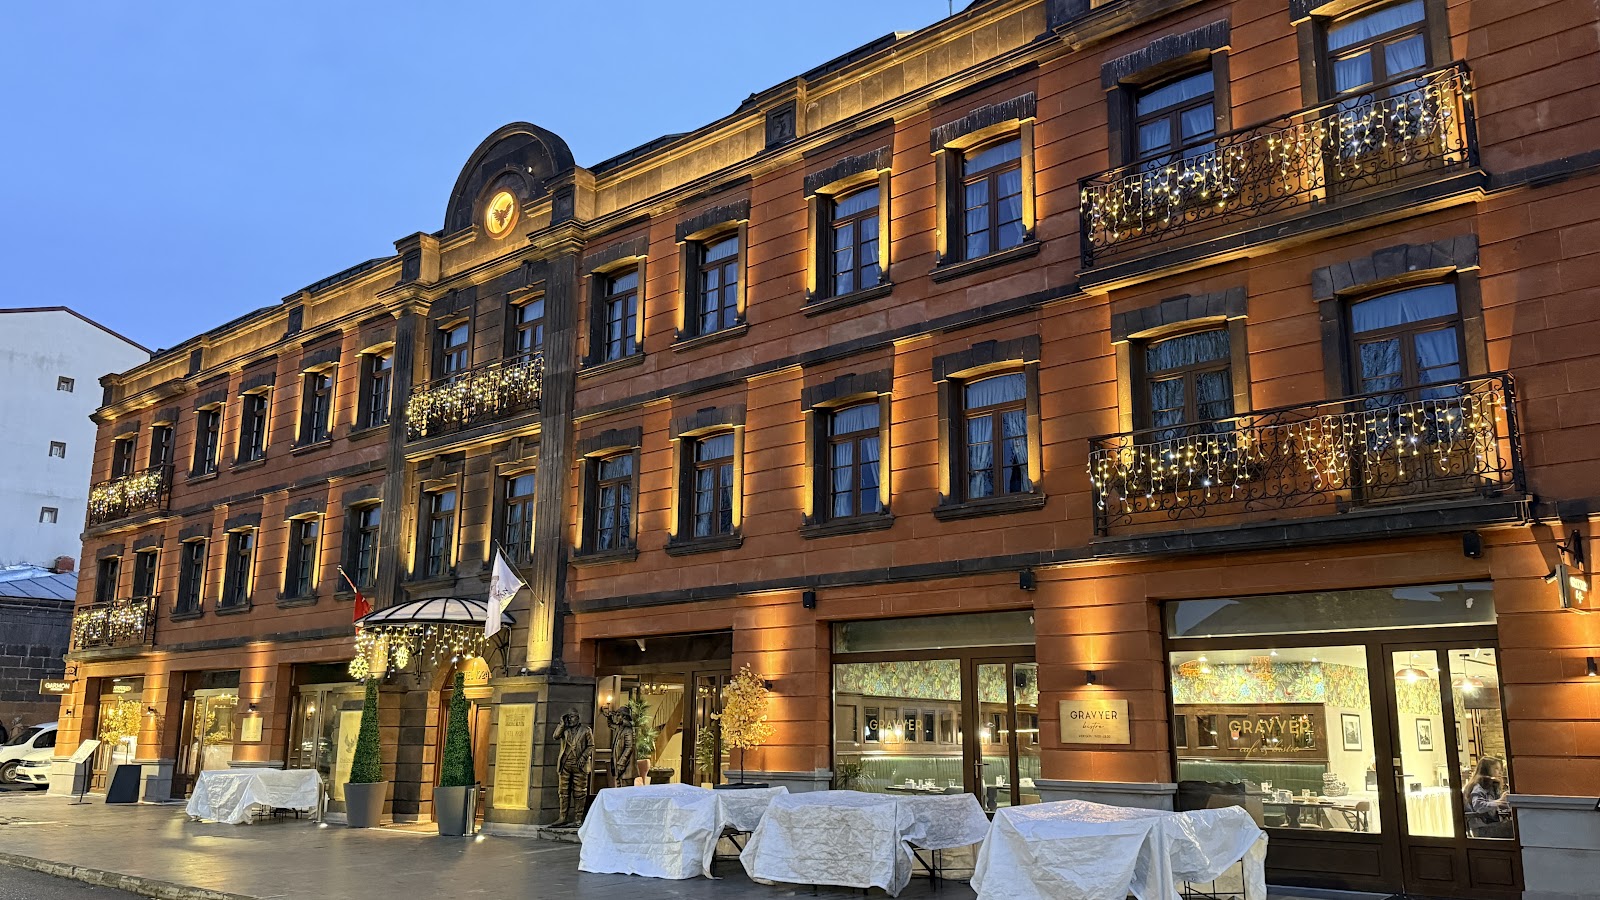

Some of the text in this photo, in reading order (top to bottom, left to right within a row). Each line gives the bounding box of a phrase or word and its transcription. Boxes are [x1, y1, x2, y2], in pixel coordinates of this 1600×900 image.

[44, 682, 71, 690] GARMON
[1070, 710, 1118, 720] GRAVYER
[869, 719, 923, 731] GRAVYER
[1228, 720, 1310, 734] GRAVYER
